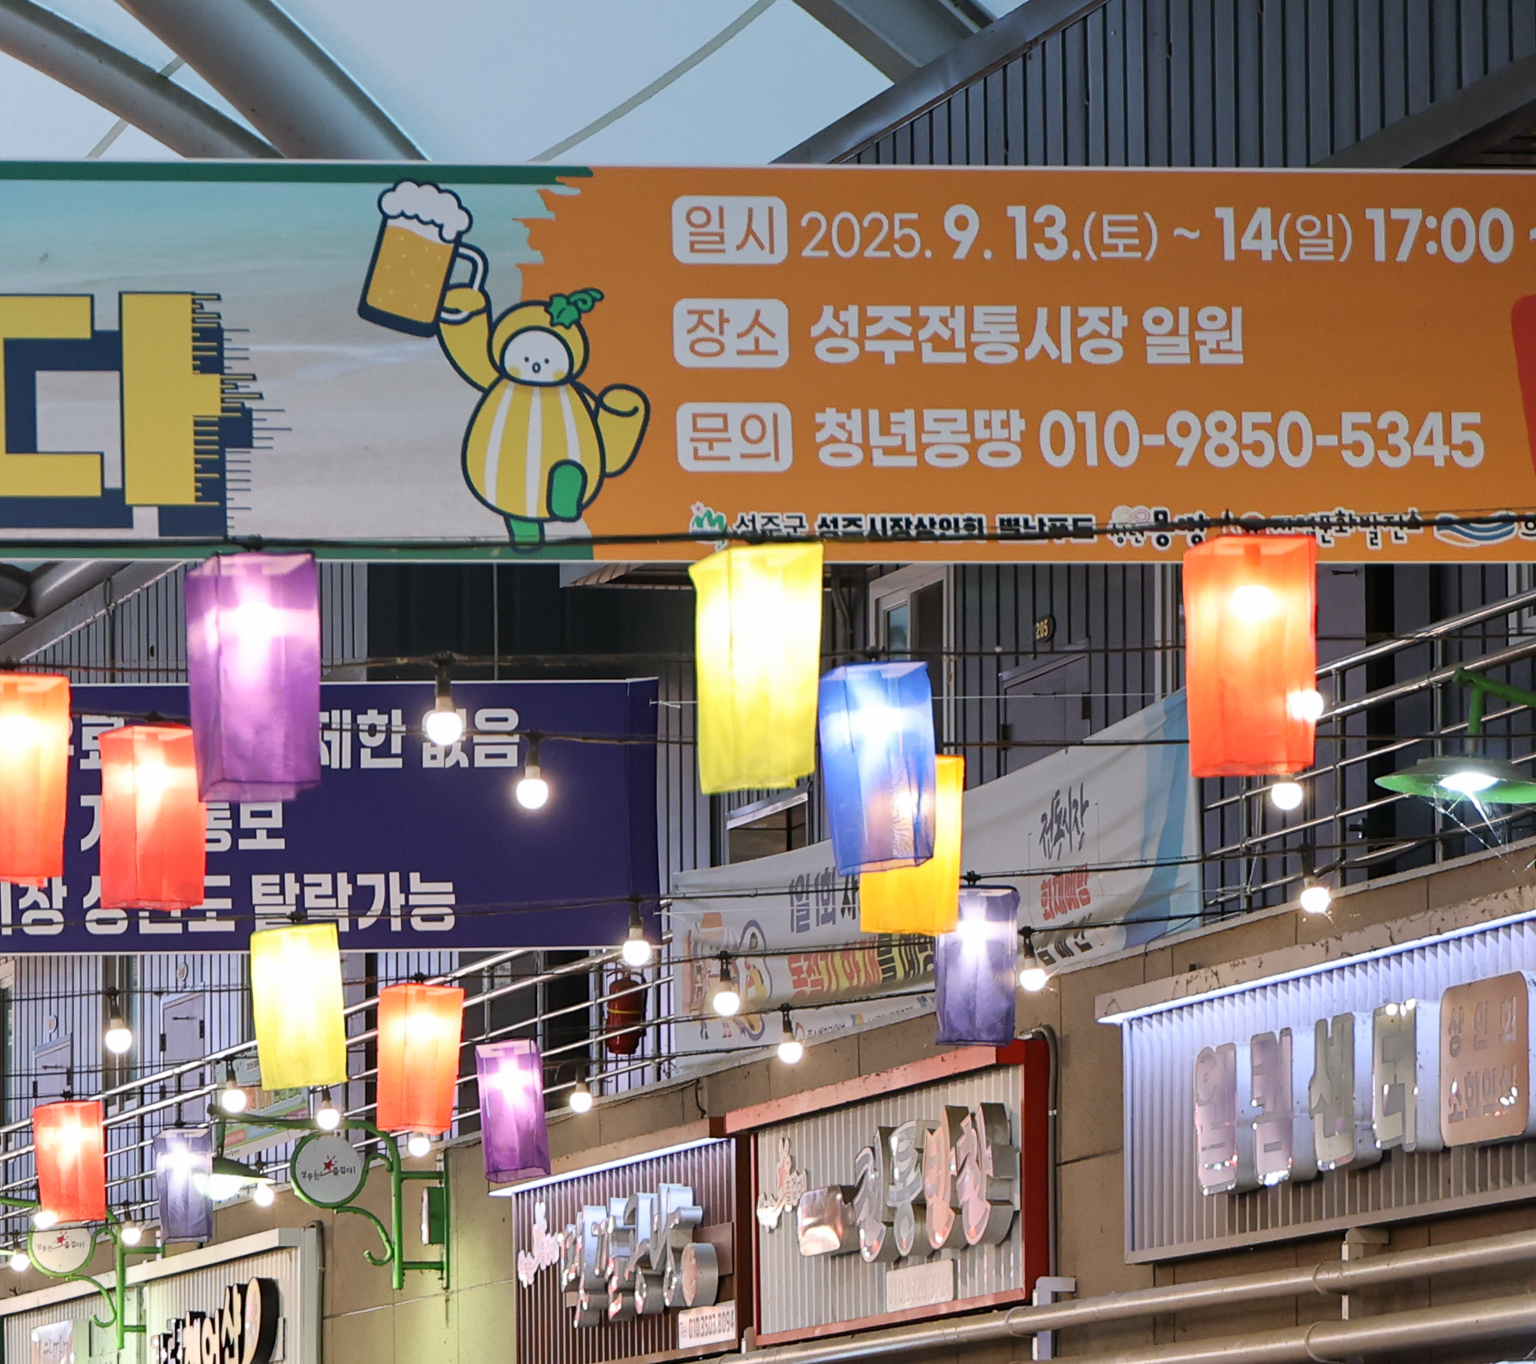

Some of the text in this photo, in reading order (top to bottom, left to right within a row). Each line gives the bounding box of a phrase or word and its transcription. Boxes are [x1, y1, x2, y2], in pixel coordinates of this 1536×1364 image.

[685, 205, 776, 255] 일시
[800, 211, 933, 260] 2025.
[1214, 206, 1353, 262] 14(일)
[1365, 207, 1515, 264] 17:00
[686, 304, 1244, 366] 장소 성주전통시장 일원
[689, 407, 1485, 470] 문의 청년몽땅 010-9850-5345
[250, 870, 457, 932] 탈락가능
